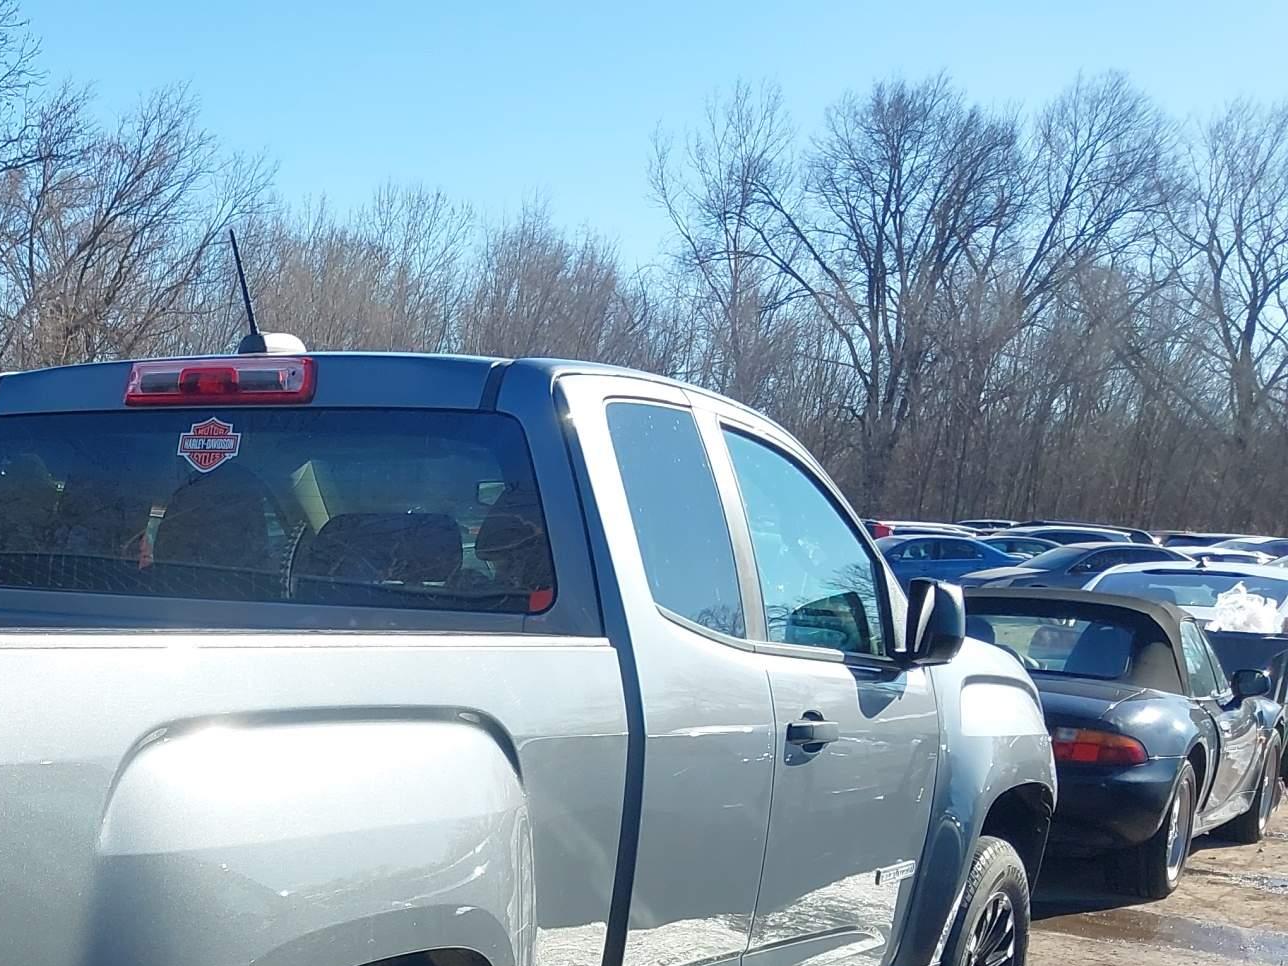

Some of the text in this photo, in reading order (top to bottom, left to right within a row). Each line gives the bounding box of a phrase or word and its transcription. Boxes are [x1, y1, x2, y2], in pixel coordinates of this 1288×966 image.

[198, 425, 225, 436] MOTOR
[184, 438, 234, 450] HARLEY-DAVIDSON
[193, 453, 221, 465] CYCLES
